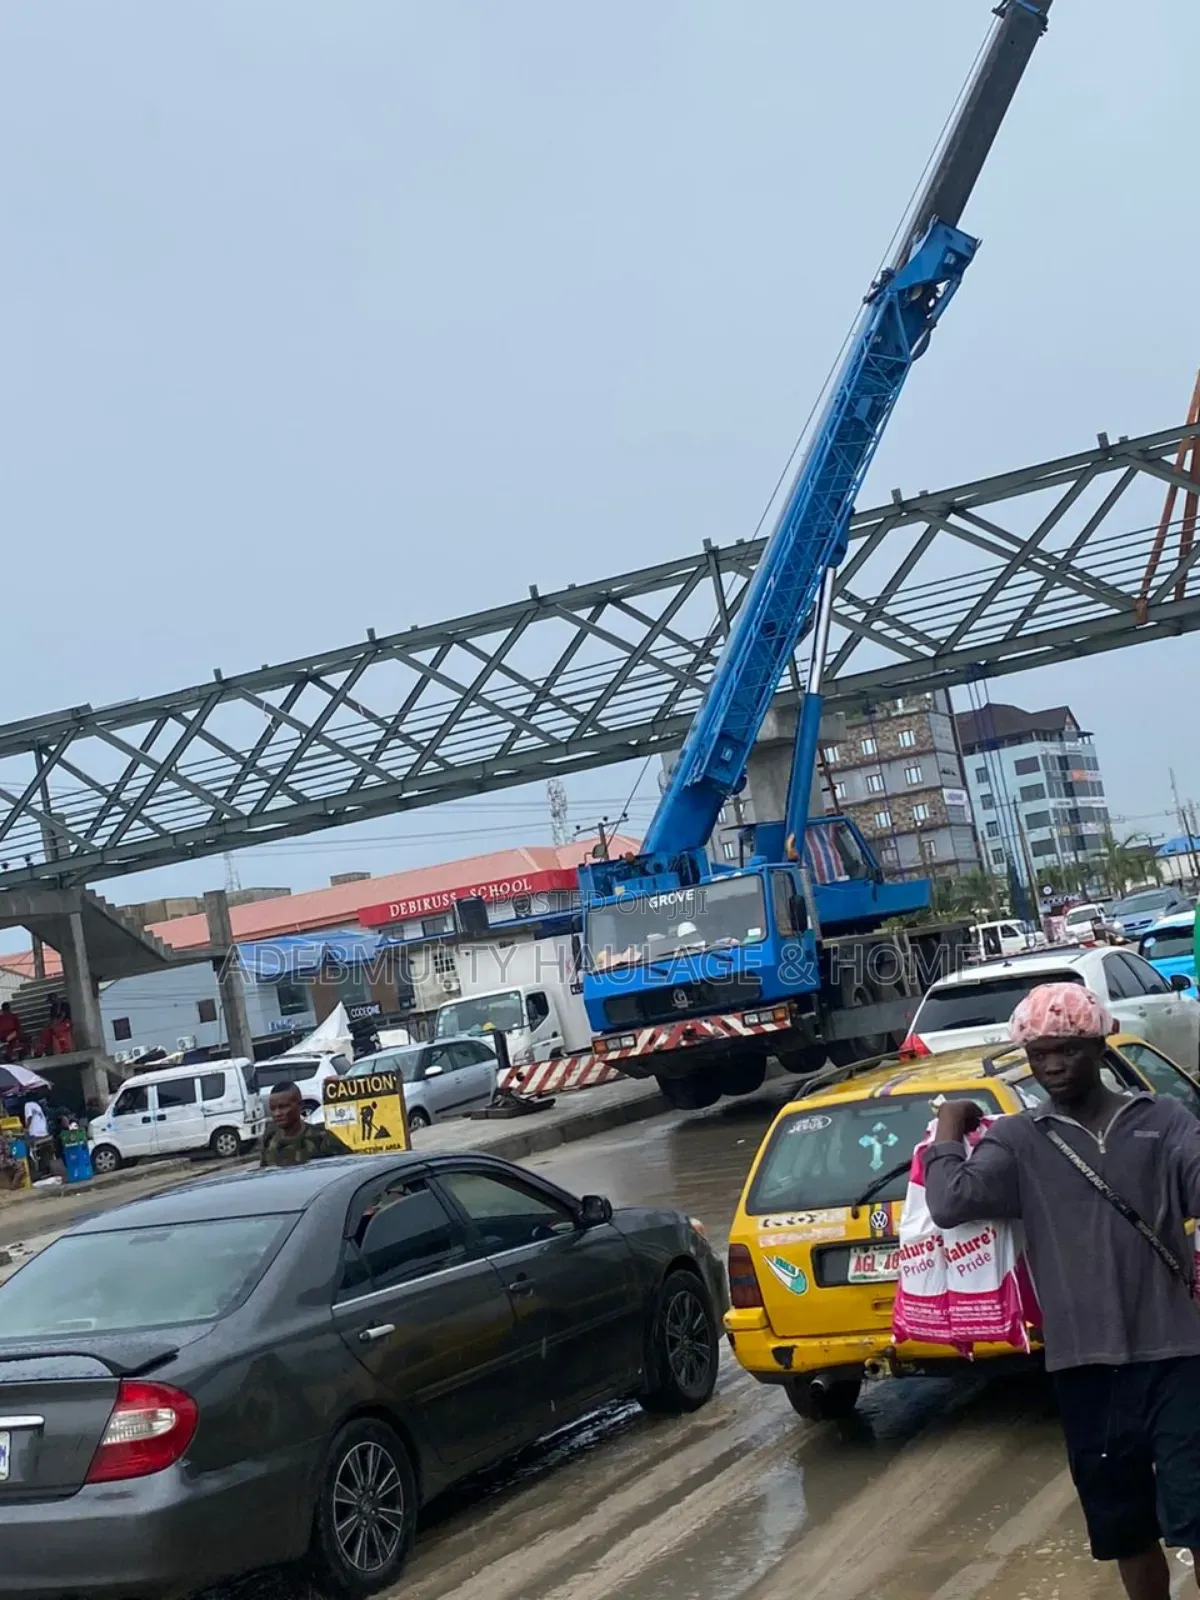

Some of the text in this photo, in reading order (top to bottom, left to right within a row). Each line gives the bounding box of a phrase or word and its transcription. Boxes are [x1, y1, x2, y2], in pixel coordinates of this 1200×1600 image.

[389, 878, 532, 917] DEBIRUSS SCHOOL
[648, 888, 695, 909] GROVE
[326, 1074, 394, 1099] CAUTION
[956, 1252, 992, 1277] Pride
